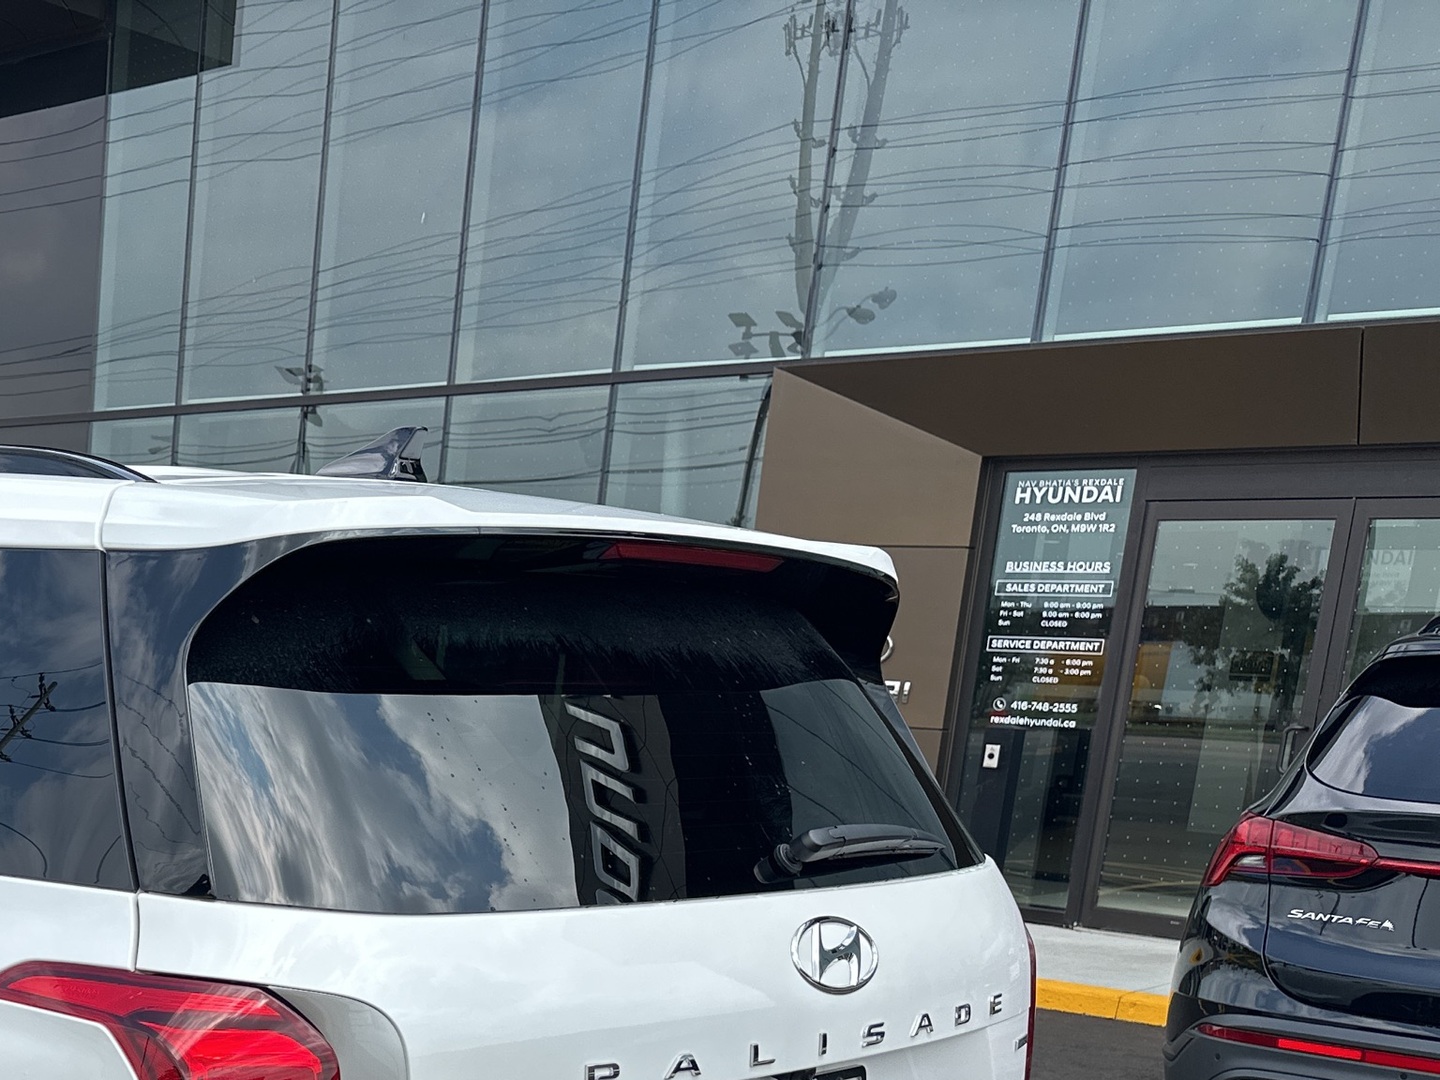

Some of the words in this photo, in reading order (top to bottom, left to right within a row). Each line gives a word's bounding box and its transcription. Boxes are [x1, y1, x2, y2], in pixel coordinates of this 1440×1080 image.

[1082, 478, 1124, 486] REXDALE
[1015, 485, 1123, 504] HYUNDAI
[1023, 512, 1042, 521] 248
[1044, 512, 1082, 521] Rexdale
[1084, 512, 1107, 521] Blvd
[1011, 524, 1050, 533] Toronto,
[1071, 523, 1098, 533] M9W
[1099, 523, 1116, 532] 1R2
[1005, 561, 1064, 572] BUSINESS
[1067, 561, 1111, 572] HOURS
[1005, 583, 1036, 592] SALES
[1037, 583, 1105, 593] DEPARTMENT
[991, 639, 1032, 649] SERVICE
[1033, 640, 1100, 651] DEPARTMENT
[1032, 676, 1059, 684] CLOSED
[990, 715, 1076, 728] rexdalehyundai.ca
